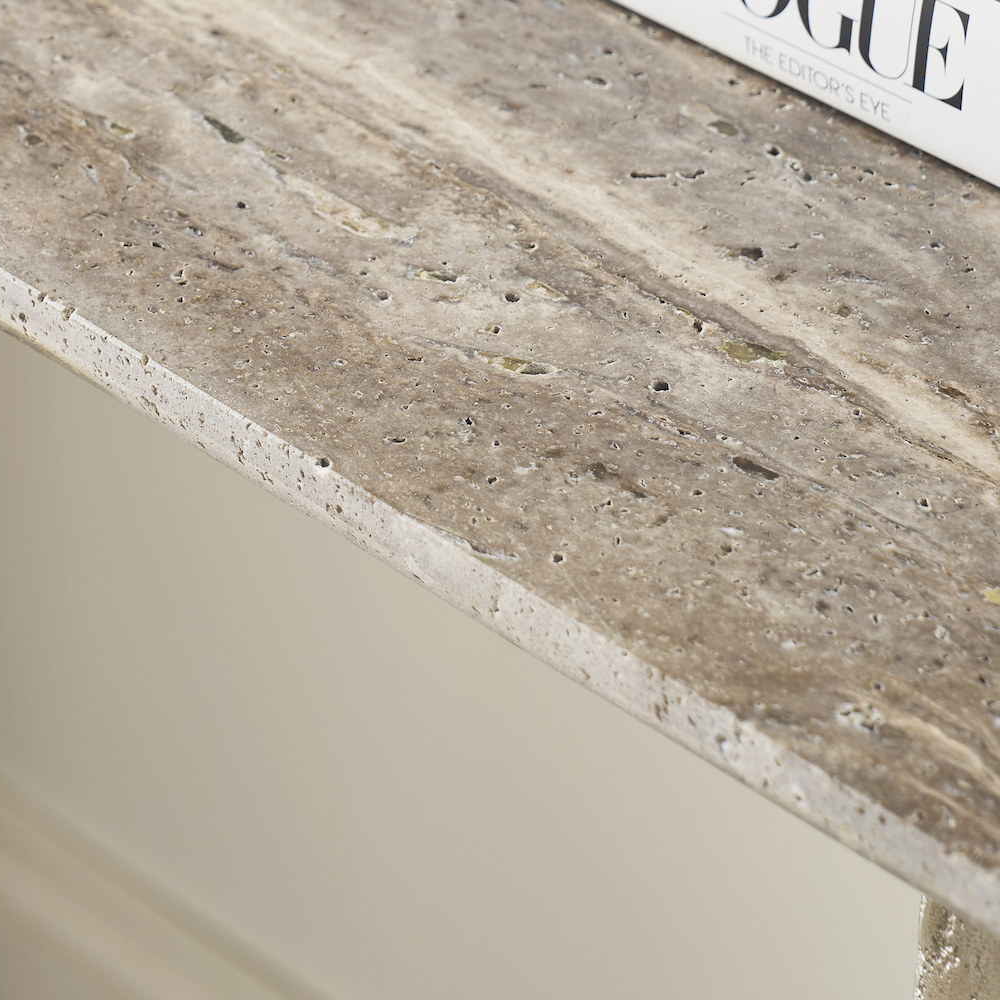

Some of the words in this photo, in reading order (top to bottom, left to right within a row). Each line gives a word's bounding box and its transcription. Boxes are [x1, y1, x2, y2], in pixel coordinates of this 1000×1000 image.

[743, 34, 774, 66] THE
[778, 52, 855, 104] EDITOR'S
[860, 91, 892, 122] EYE
